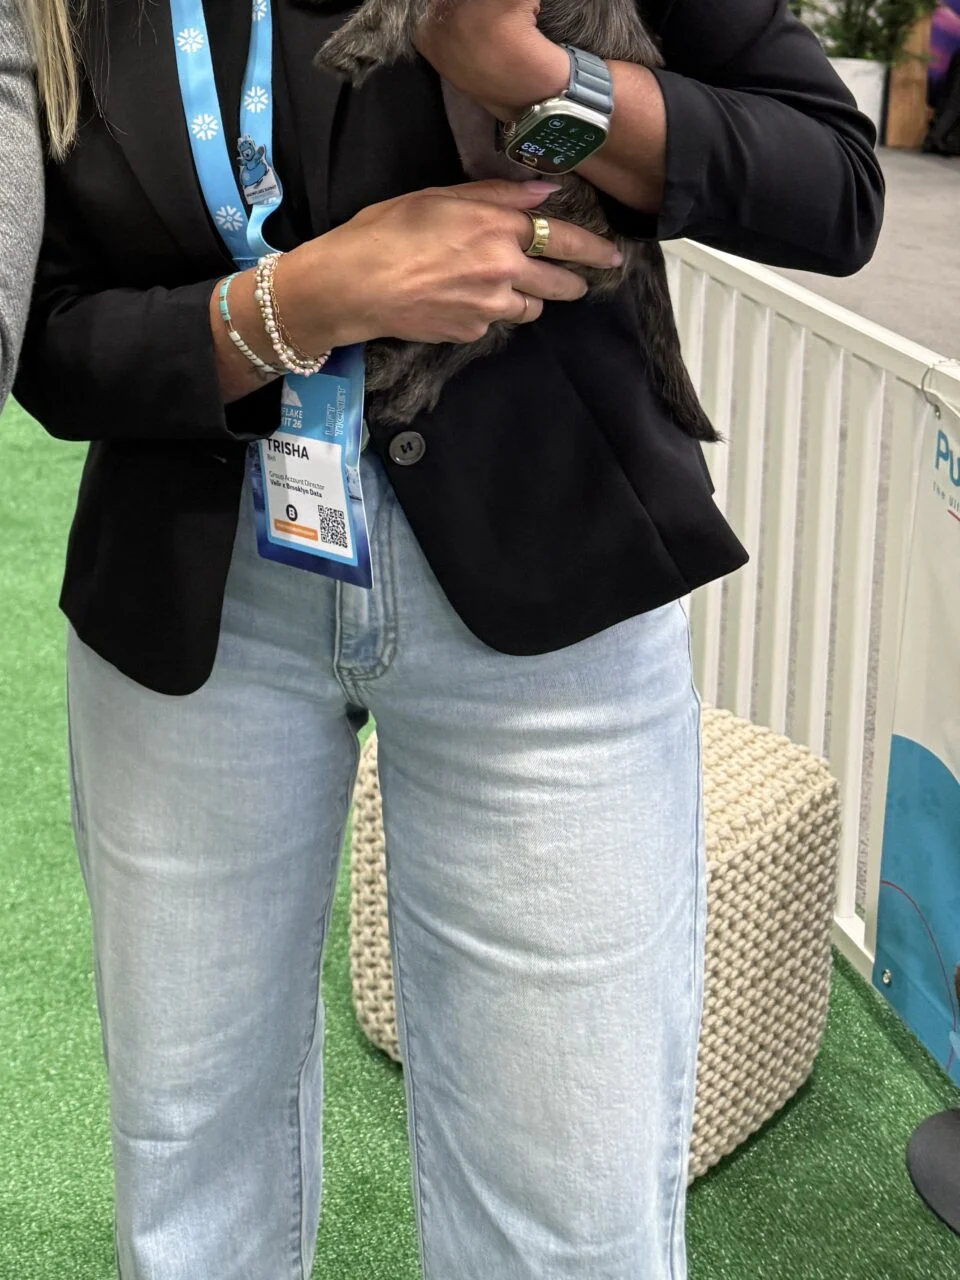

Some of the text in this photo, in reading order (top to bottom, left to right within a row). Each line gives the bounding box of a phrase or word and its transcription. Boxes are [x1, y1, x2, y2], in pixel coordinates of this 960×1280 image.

[281, 407, 303, 419] FLAKE
[266, 438, 310, 461] TRISHA
[935, 430, 960, 487] Pu
